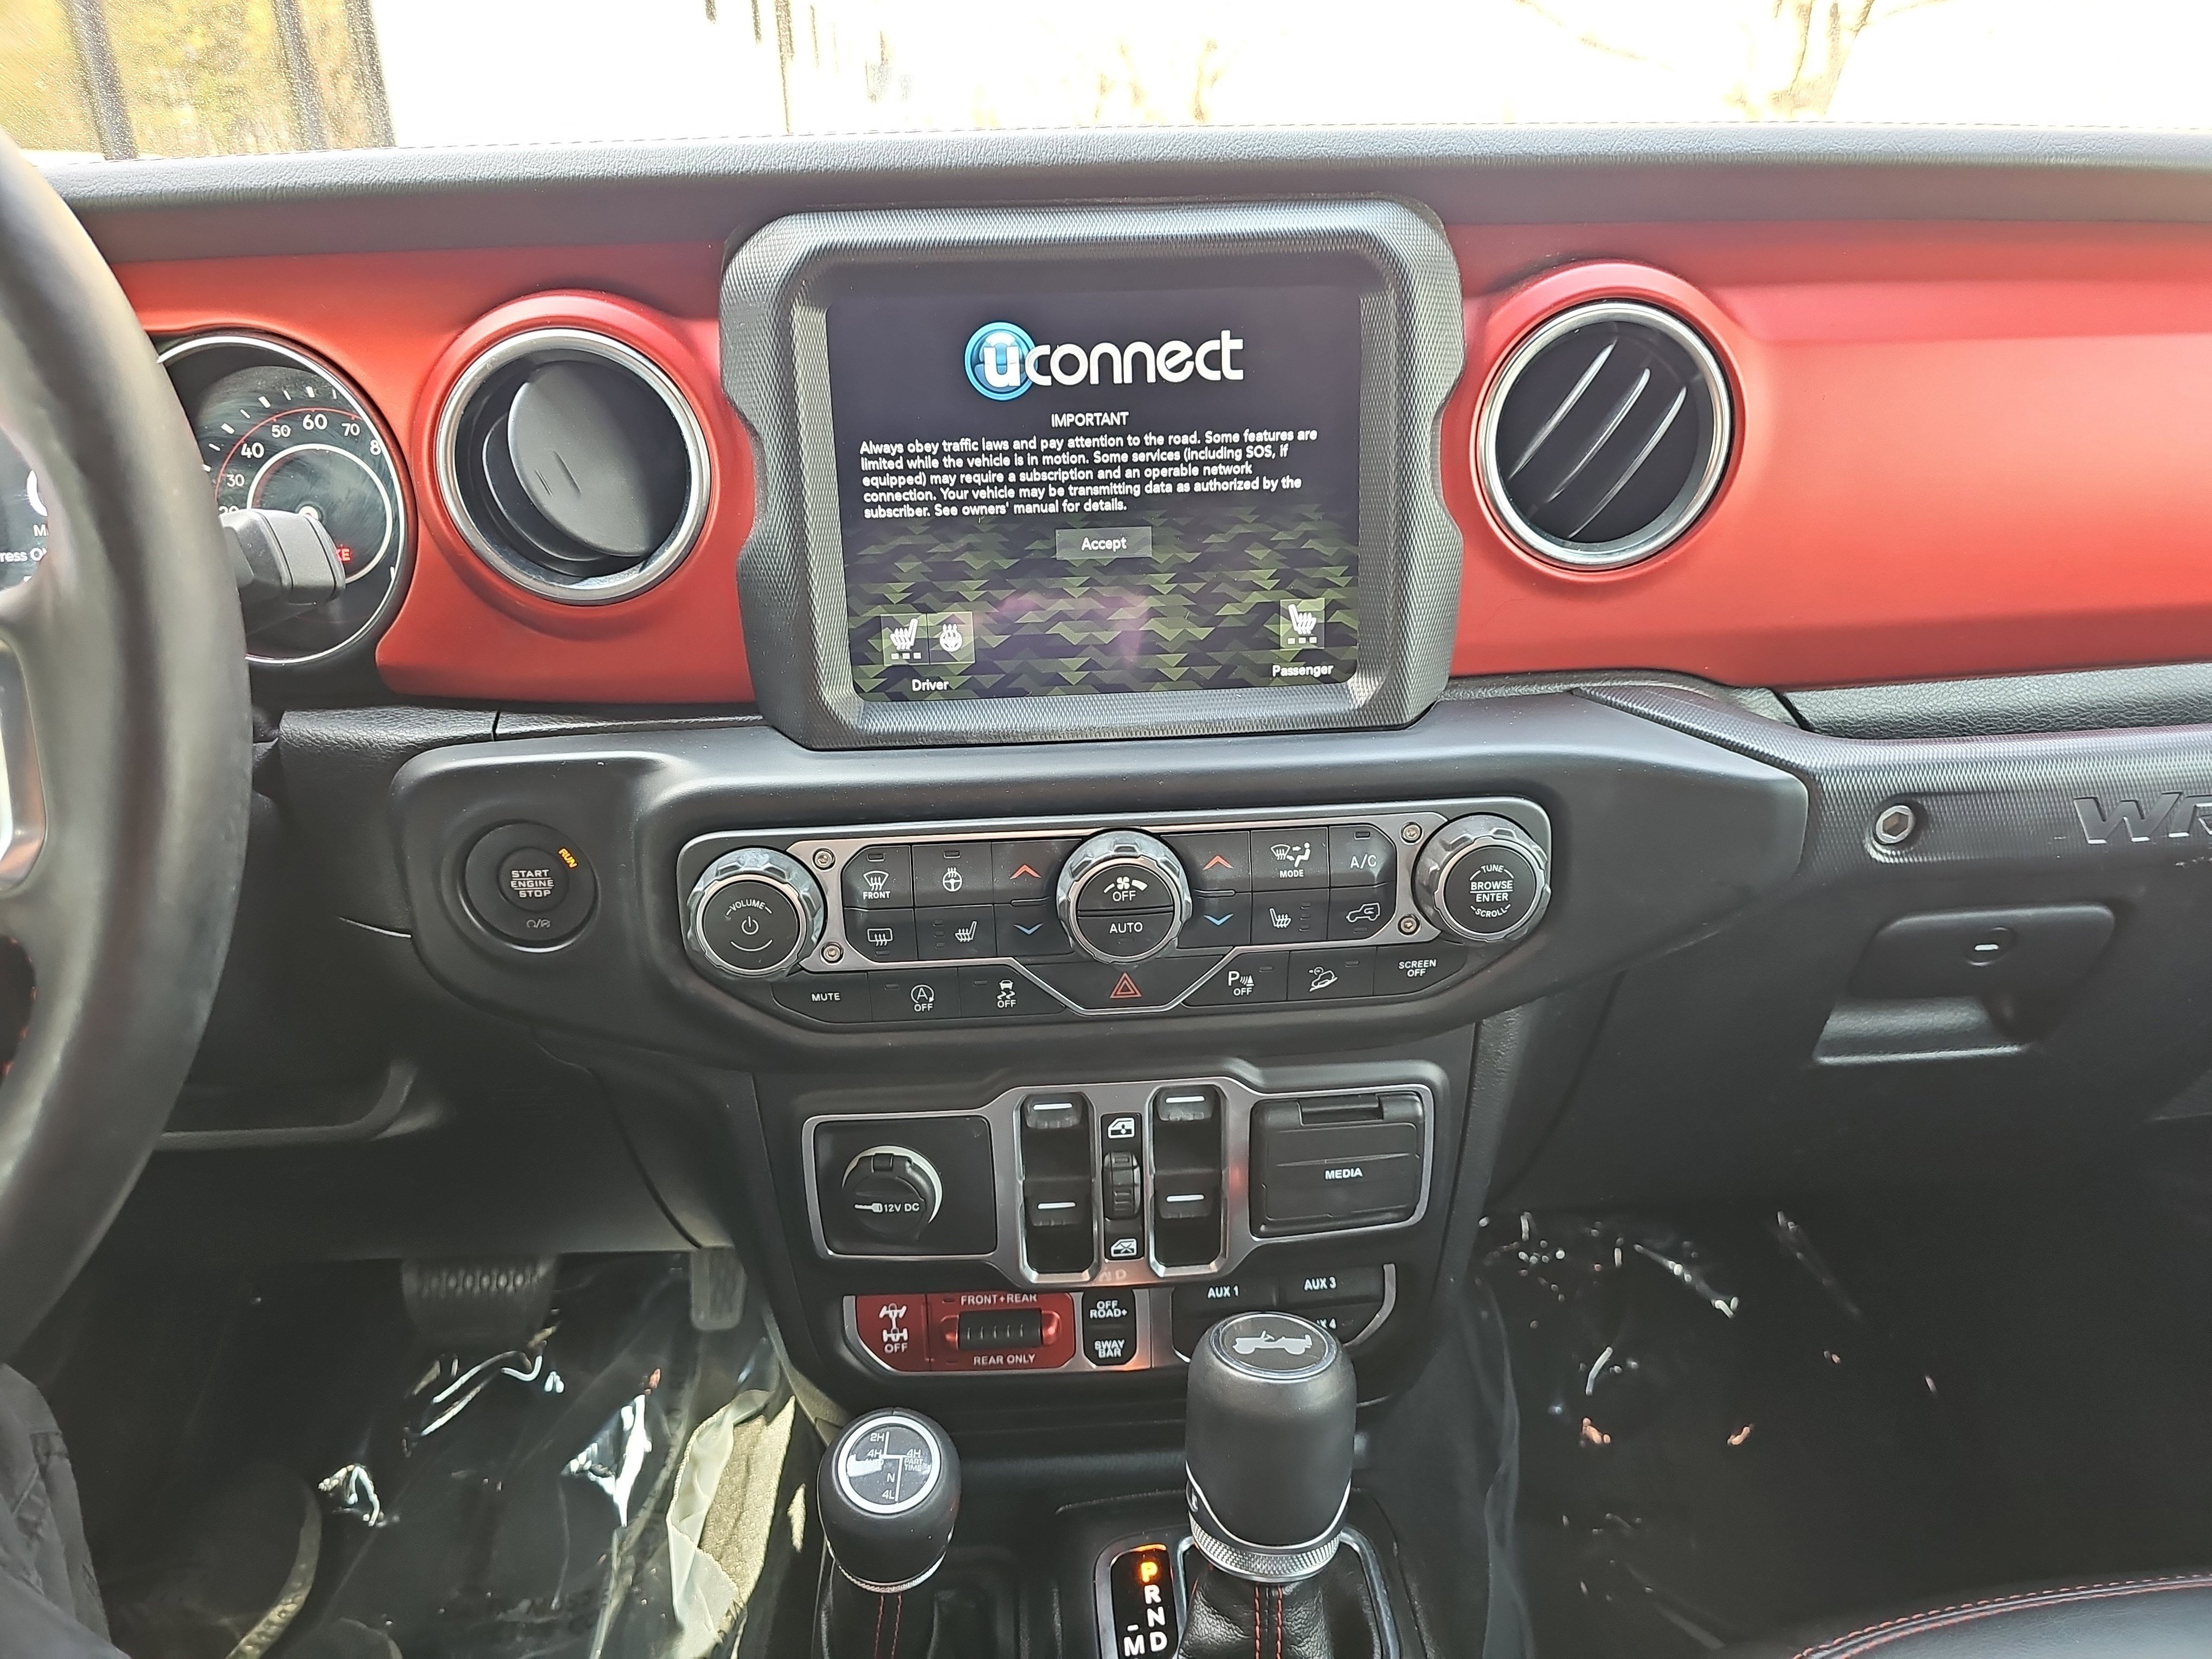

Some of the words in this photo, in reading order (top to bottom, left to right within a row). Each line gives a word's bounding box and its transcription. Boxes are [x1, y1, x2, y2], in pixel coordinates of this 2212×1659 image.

[303, 414, 327, 430] 60
[1051, 411, 1129, 427] IMPORTANT
[272, 425, 291, 438] 50
[342, 423, 361, 436] 70
[860, 440, 904, 456] Always
[907, 439, 938, 455] obey
[942, 438, 979, 452] traffic
[982, 436, 1009, 451] laws
[1013, 435, 1036, 451] and
[1041, 438, 1064, 452] pay
[1068, 434, 1123, 450] attention
[1127, 435, 1140, 447] to
[1143, 432, 1164, 446] the
[1168, 430, 1201, 445] road.
[1205, 430, 1239, 444] Some
[1243, 429, 1294, 442] features
[1297, 430, 1317, 441] are
[241, 442, 265, 459] 40
[860, 456, 903, 471] limited
[906, 455, 938, 469] while
[942, 454, 963, 468] the
[967, 453, 1010, 467] vehicle
[1014, 453, 1023, 466] is
[1027, 452, 1038, 466] in
[1042, 452, 1089, 465] motion.
[1094, 451, 1128, 463] Some
[1132, 449, 1180, 462] services
[1184, 447, 1242, 462] (including
[1246, 445, 1275, 459] SOS,
[1280, 443, 1288, 457] if
[227, 474, 245, 487] 30
[862, 471, 926, 488] equipped)
[930, 473, 956, 486] may
[960, 470, 1004, 486] require
[1008, 472, 1015, 482] a
[1019, 468, 1094, 483] subscription
[1097, 466, 1121, 479] and
[1125, 468, 1140, 478] an
[1144, 463, 1199, 480] operable
[1204, 461, 1252, 475] network
[864, 489, 936, 502] connection.
[940, 487, 969, 500] Your
[972, 485, 1015, 499] vehicle
[1019, 487, 1045, 500] may
[1049, 484, 1064, 497] be
[1068, 482, 1140, 497] transmitting
[1144, 480, 1173, 493] data
[1176, 482, 1190, 492] as
[1194, 477, 1259, 492] authorized
[1263, 476, 1278, 491] by
[1281, 475, 1302, 488] the
[864, 505, 930, 518] subscriber.
[934, 504, 957, 516] See
[962, 502, 1009, 515] owners'
[1014, 500, 1058, 514] manual
[1062, 499, 1079, 512] for
[1084, 499, 1127, 512] details.
[33, 524, 49, 537] M
[1081, 536, 1127, 552] Accept
[1272, 664, 1334, 678] Passenger
[911, 679, 949, 691] Driver
[558, 848, 577, 867] RUN
[1350, 854, 1377, 869] A/C
[512, 870, 549, 878] START
[1279, 870, 1304, 879] MODE
[1481, 864, 1504, 874] TUNE
[510, 879, 555, 888] ENGINE
[1470, 880, 1513, 891] BROWSE
[519, 890, 551, 898] STOP
[862, 891, 891, 900] FRONT
[1112, 890, 1136, 902] OFF
[1476, 892, 1509, 903] ENTER
[730, 900, 766, 912] VOLUME
[1475, 905, 1507, 917] SCROLL
[1109, 922, 1143, 934] AUTO
[1399, 959, 1437, 969] SCREEN
[1228, 970, 1240, 986] P
[1407, 968, 1426, 977] OFF
[812, 992, 840, 1002] MUTE
[1233, 987, 1253, 996] OFF
[914, 1003, 934, 1012] OFF
[997, 999, 1017, 1009] OFF
[1324, 1167, 1363, 1180] MEDIA
[884, 1203, 902, 1212] 12V
[904, 1203, 920, 1212] DC
[1304, 1277, 1328, 1291] AUX
[1329, 1276, 1337, 1289] 3
[1207, 1285, 1231, 1298] AUX
[1233, 1285, 1239, 1297] 1
[1096, 1300, 1118, 1310] OFF
[1329, 1318, 1336, 1329] 4
[884, 1343, 908, 1353] OFF
[1095, 1339, 1125, 1351] SWAY
[1098, 1348, 1122, 1358] BAR
[974, 1355, 1003, 1365] REAR
[1006, 1354, 1036, 1365] ONLY
[870, 1432, 885, 1442] 2H
[867, 1448, 883, 1458] 4H
[906, 1449, 921, 1458] 4H
[886, 1472, 896, 1483] N
[882, 1489, 895, 1500] 4L
[1141, 1562, 1158, 1583] P
[1144, 1584, 1162, 1604] R
[1147, 1606, 1166, 1627] N
[1124, 1634, 1145, 1657] M
[1150, 1631, 1167, 1652] D
